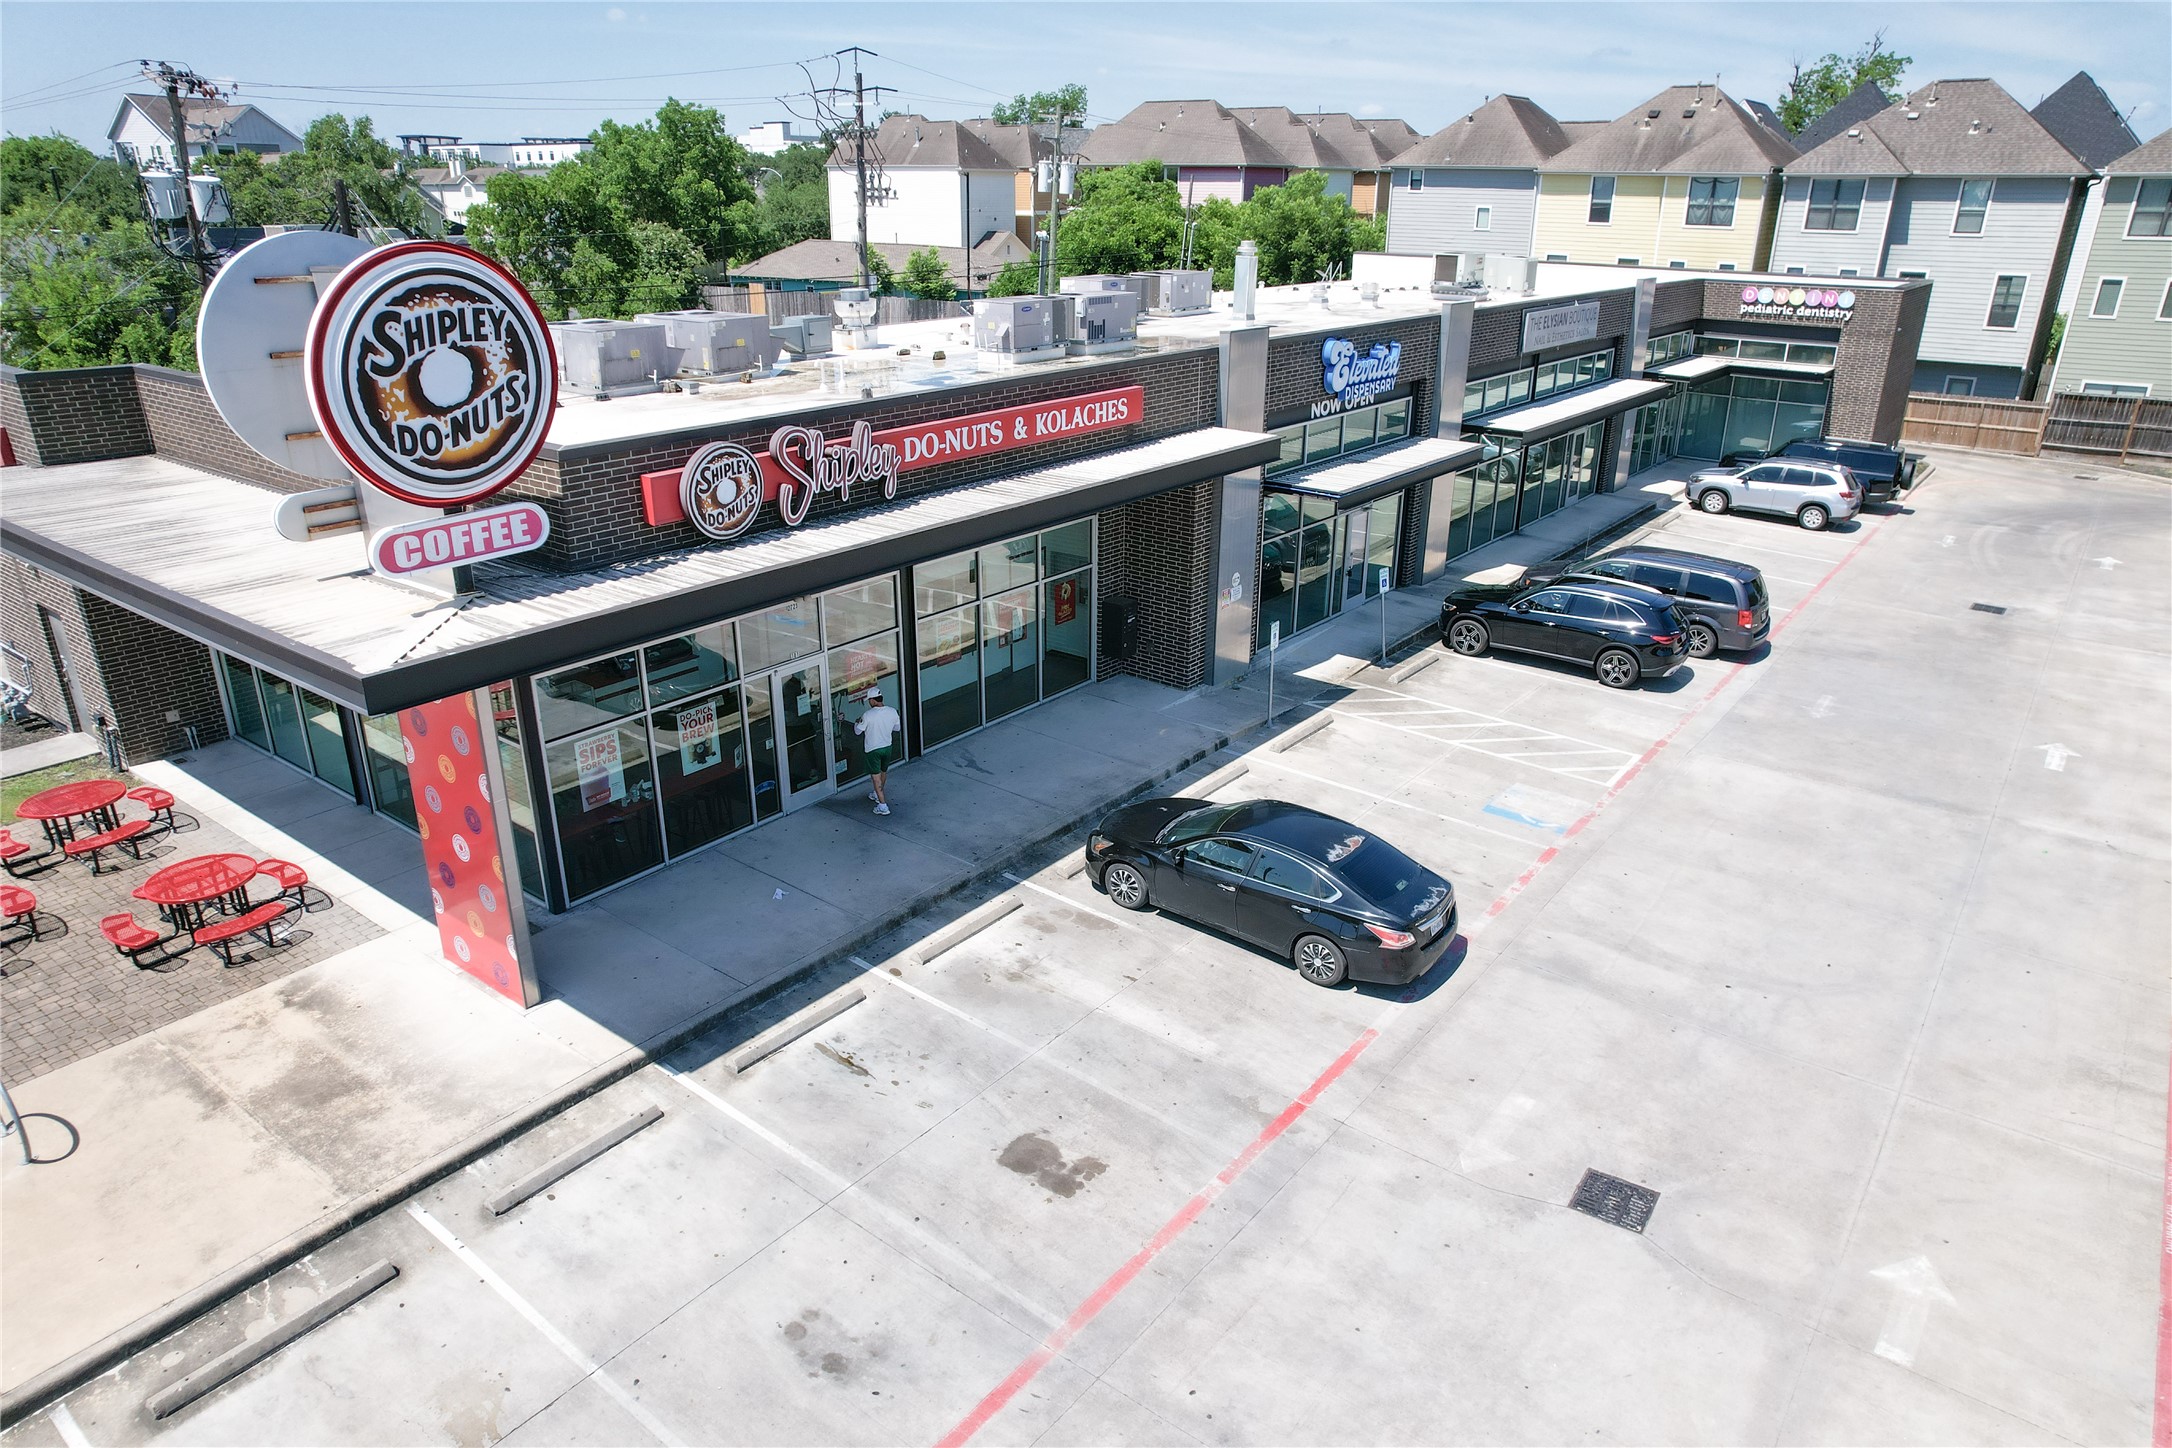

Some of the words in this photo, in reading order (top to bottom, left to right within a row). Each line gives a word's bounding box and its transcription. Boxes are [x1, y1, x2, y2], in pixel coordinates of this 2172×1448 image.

[1530, 318, 1542, 332] THE
[1543, 312, 1569, 329] ELYSIAN
[1569, 307, 1598, 324] BOUTIQUE
[1740, 303, 1794, 315] pediatric
[1796, 305, 1853, 320] dentistry
[370, 307, 507, 377] SHIPLEY
[1325, 338, 1401, 393] Elevated
[1345, 377, 1396, 399] DISPENSARY
[395, 375, 520, 457] DO-NUTS
[1311, 399, 1341, 419] NOW
[1345, 394, 1374, 410] OPEN
[773, 421, 902, 526] Shipley
[904, 420, 1003, 462] DO-NUTS
[1013, 416, 1029, 440] &
[1036, 397, 1128, 436] KOLACHES
[698, 459, 750, 494] SHIPLEY
[707, 486, 756, 527] DO-NUTS
[393, 512, 532, 569] COFFEE
[680, 705, 713, 722] DO-PICK
[681, 713, 713, 731] YOUR
[682, 722, 715, 743] BREW
[578, 739, 617, 765] SIPS
[581, 755, 618, 773] FOREVER
